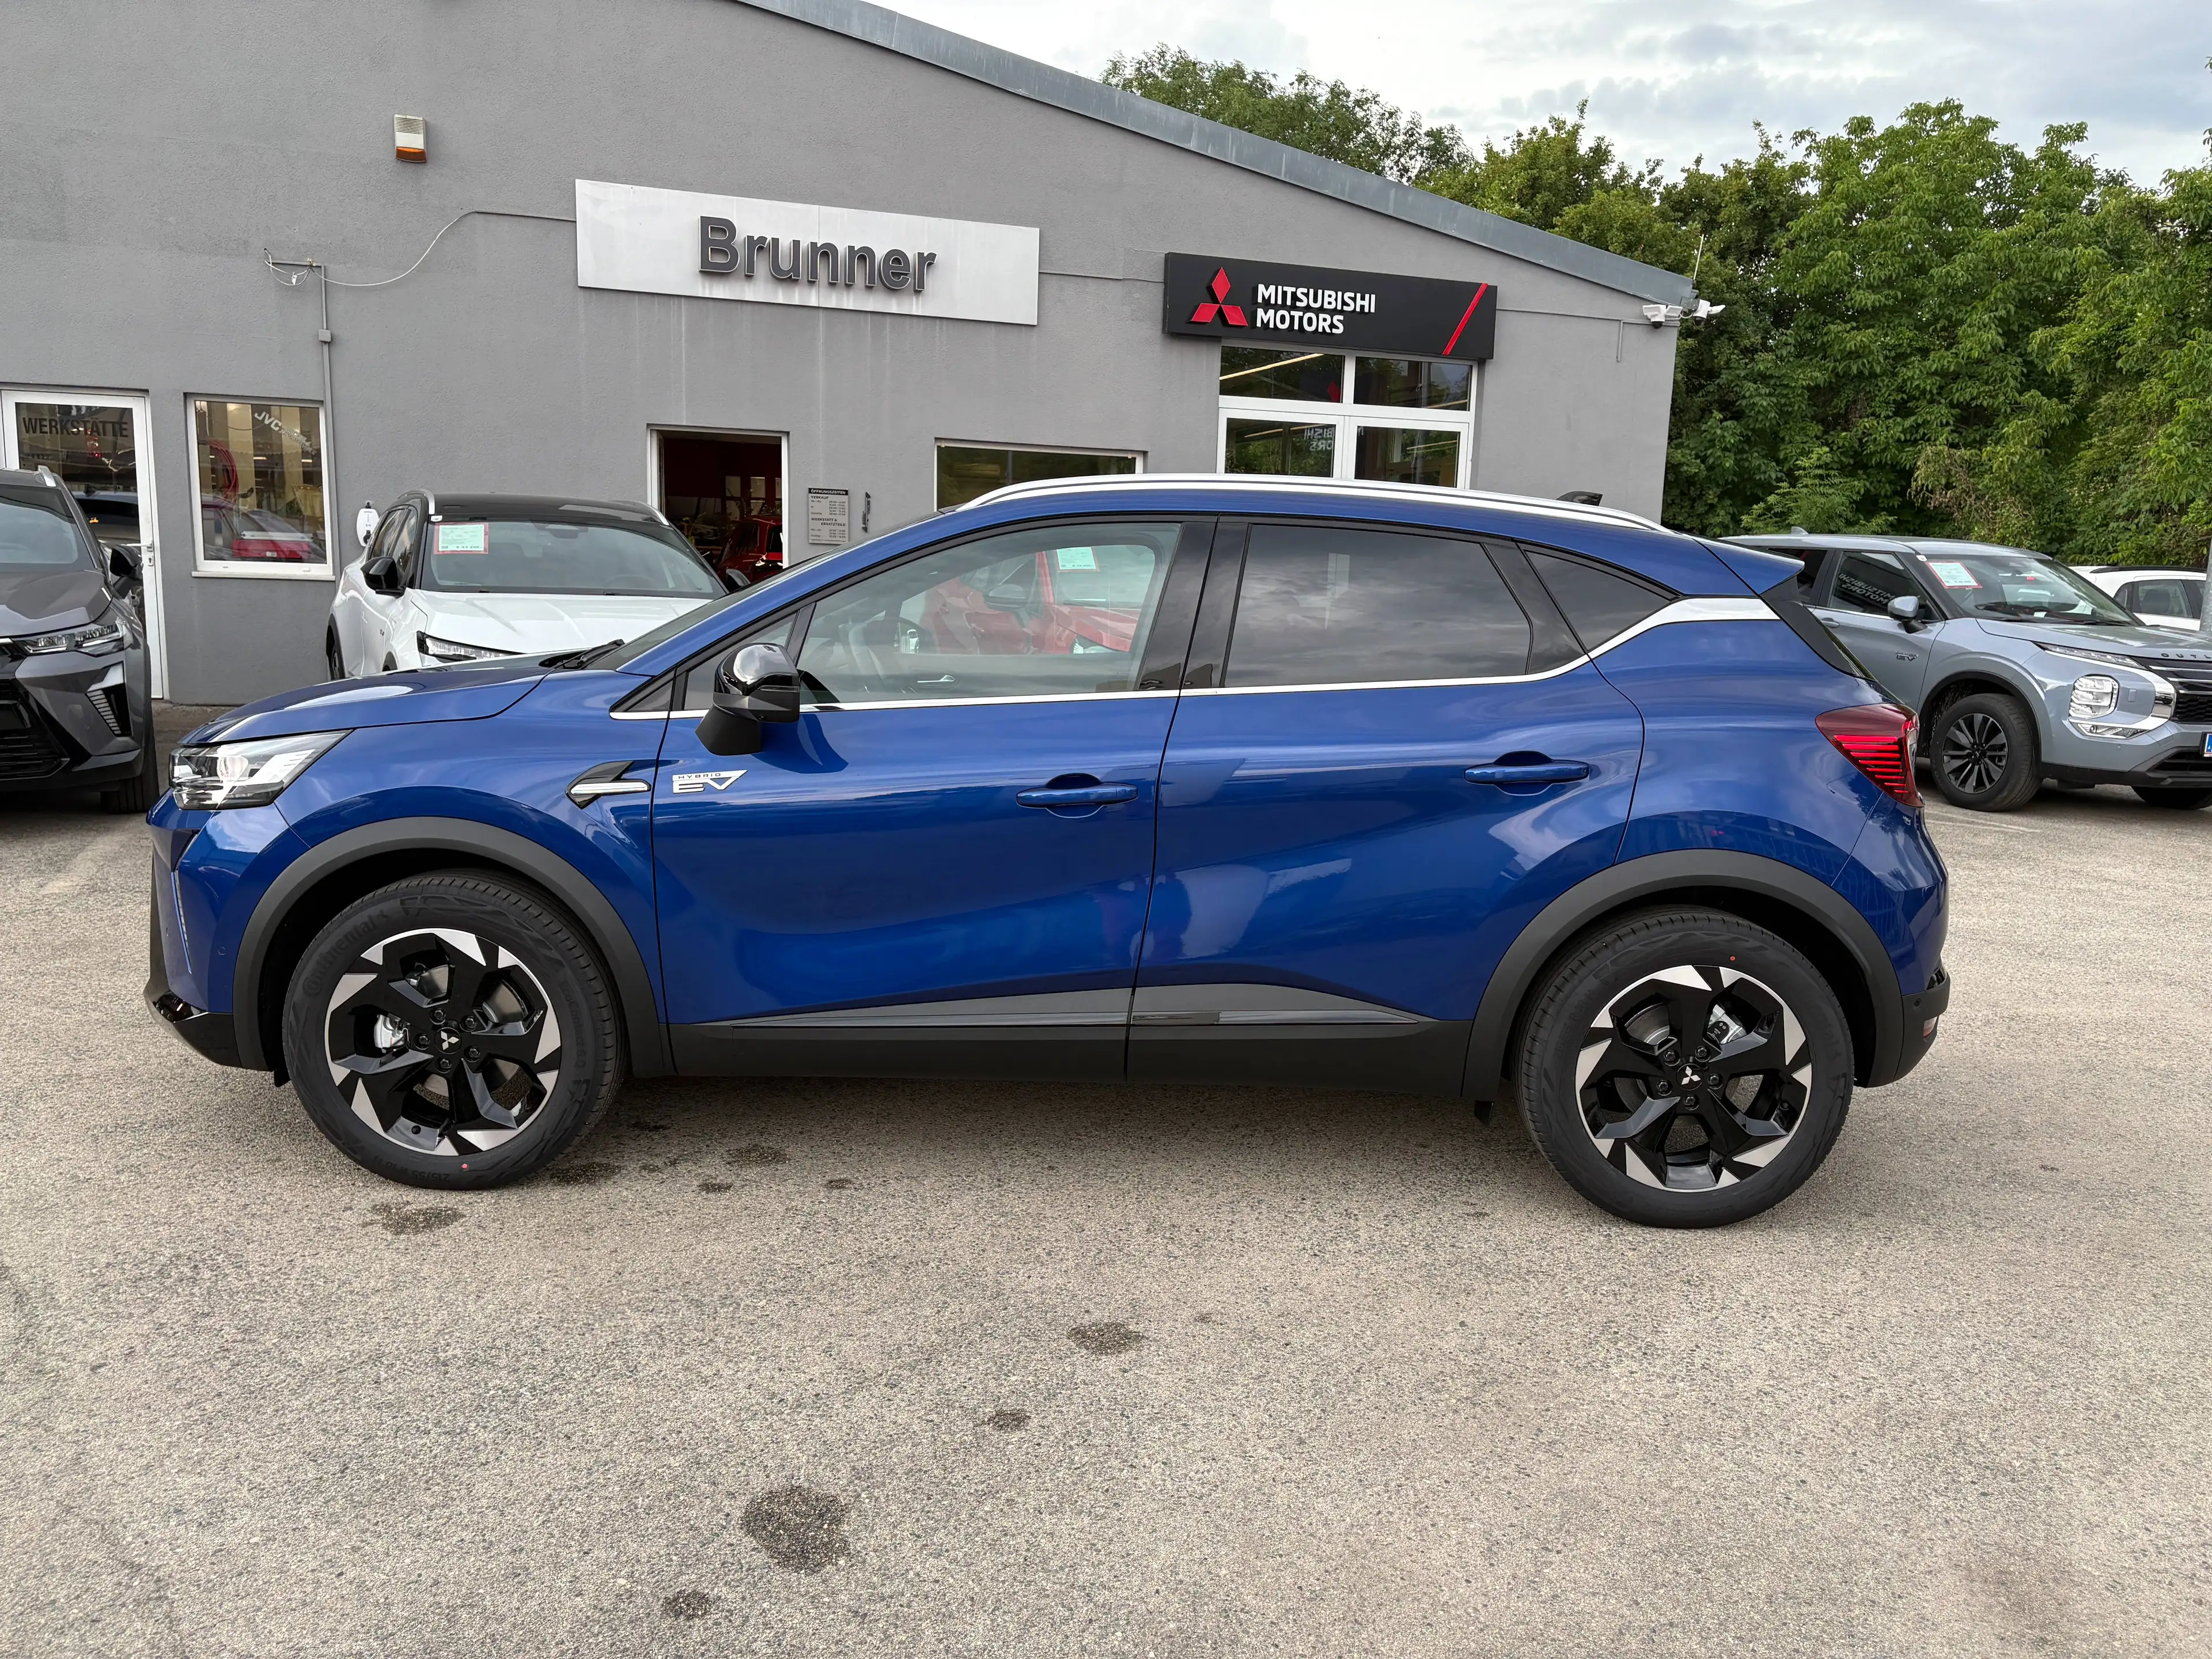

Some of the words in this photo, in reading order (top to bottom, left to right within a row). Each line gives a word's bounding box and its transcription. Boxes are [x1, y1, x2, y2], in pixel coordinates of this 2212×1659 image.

[699, 215, 937, 291] Brunner
[1256, 283, 1376, 313] MITSUBISHI
[1256, 308, 1344, 334] MOTORS
[22, 416, 128, 438] WERKSTÄTTE
[254, 411, 282, 431] JVC
[673, 775, 744, 794] EV
[302, 915, 377, 997] Continental
